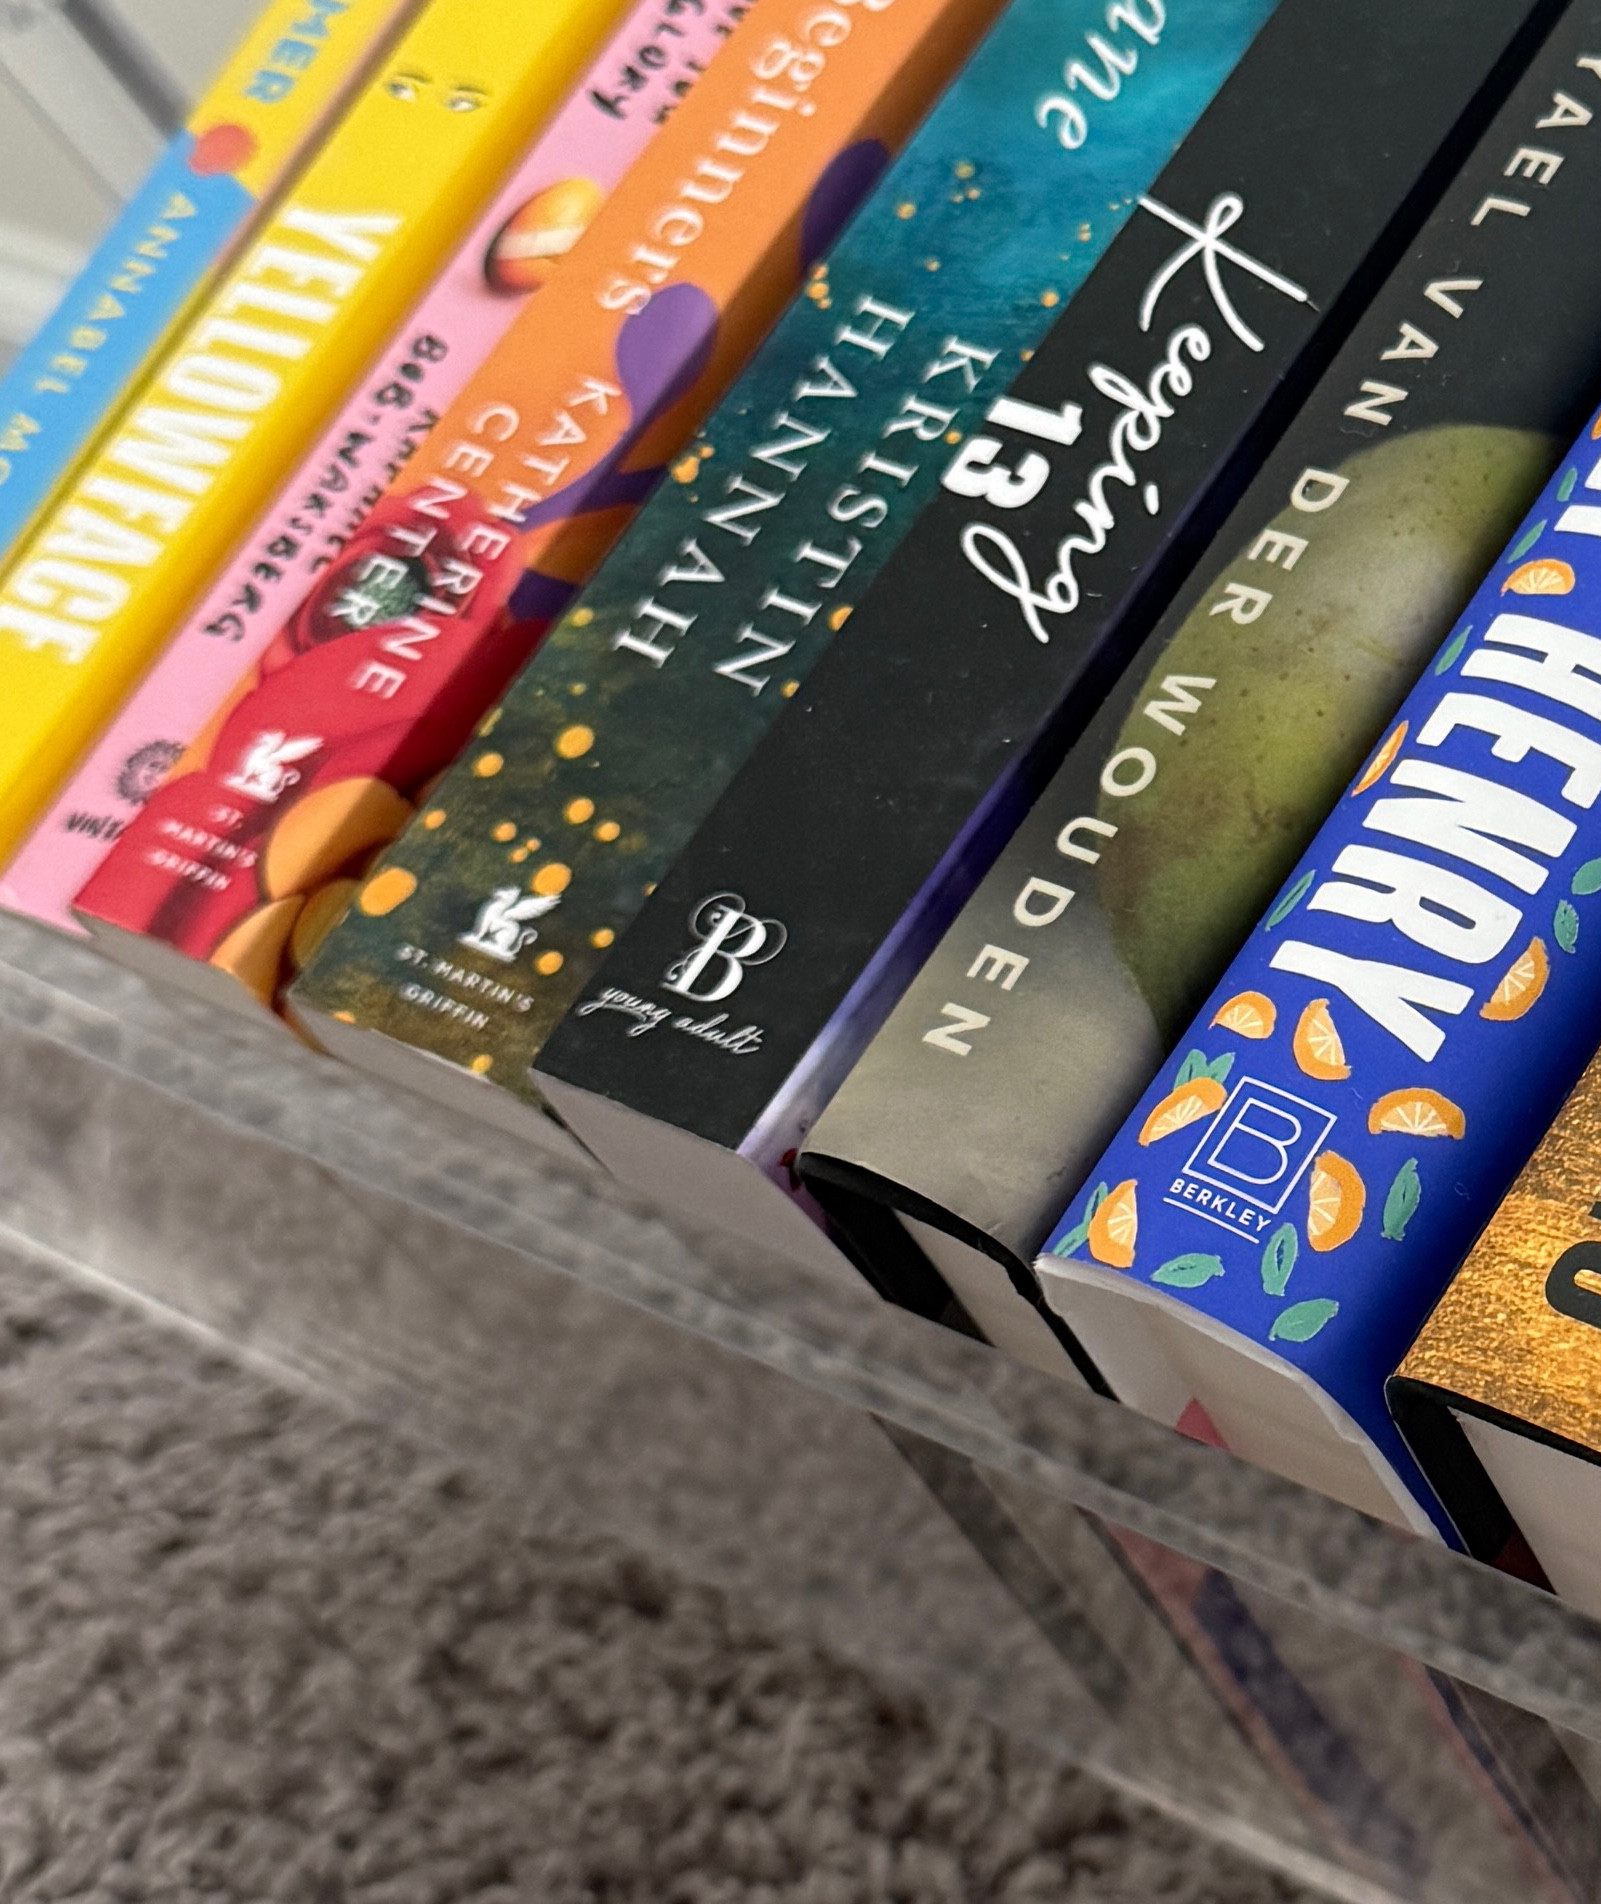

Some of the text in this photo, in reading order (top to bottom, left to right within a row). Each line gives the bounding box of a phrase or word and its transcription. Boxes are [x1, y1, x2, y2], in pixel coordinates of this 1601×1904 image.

[32, 192, 196, 395] ANNABEL
[1343, 277, 1484, 427] VAN
[2, 202, 403, 666] YELLOWFACE
[615, 296, 916, 669] HANNAH
[942, 396, 1085, 510] 13
[962, 192, 1320, 644] Keeping
[329, 401, 522, 633] CENTER
[356, 374, 622, 700] KATHERINE
[714, 336, 1000, 697] KRISTIN
[1209, 465, 1350, 626] DER
[146, 847, 232, 891] GRIFFIN
[159, 818, 259, 869] MARTIN'S
[921, 673, 1217, 1058] WOUDEN
[399, 944, 536, 1015] ST. MARTIN'S
[403, 982, 490, 1032] GRIFFIN
[576, 979, 765, 1058] young adult
[664, 892, 788, 1005] B
[1168, 1176, 1273, 1237] BERKLEY
[1207, 1097, 1304, 1186] B
